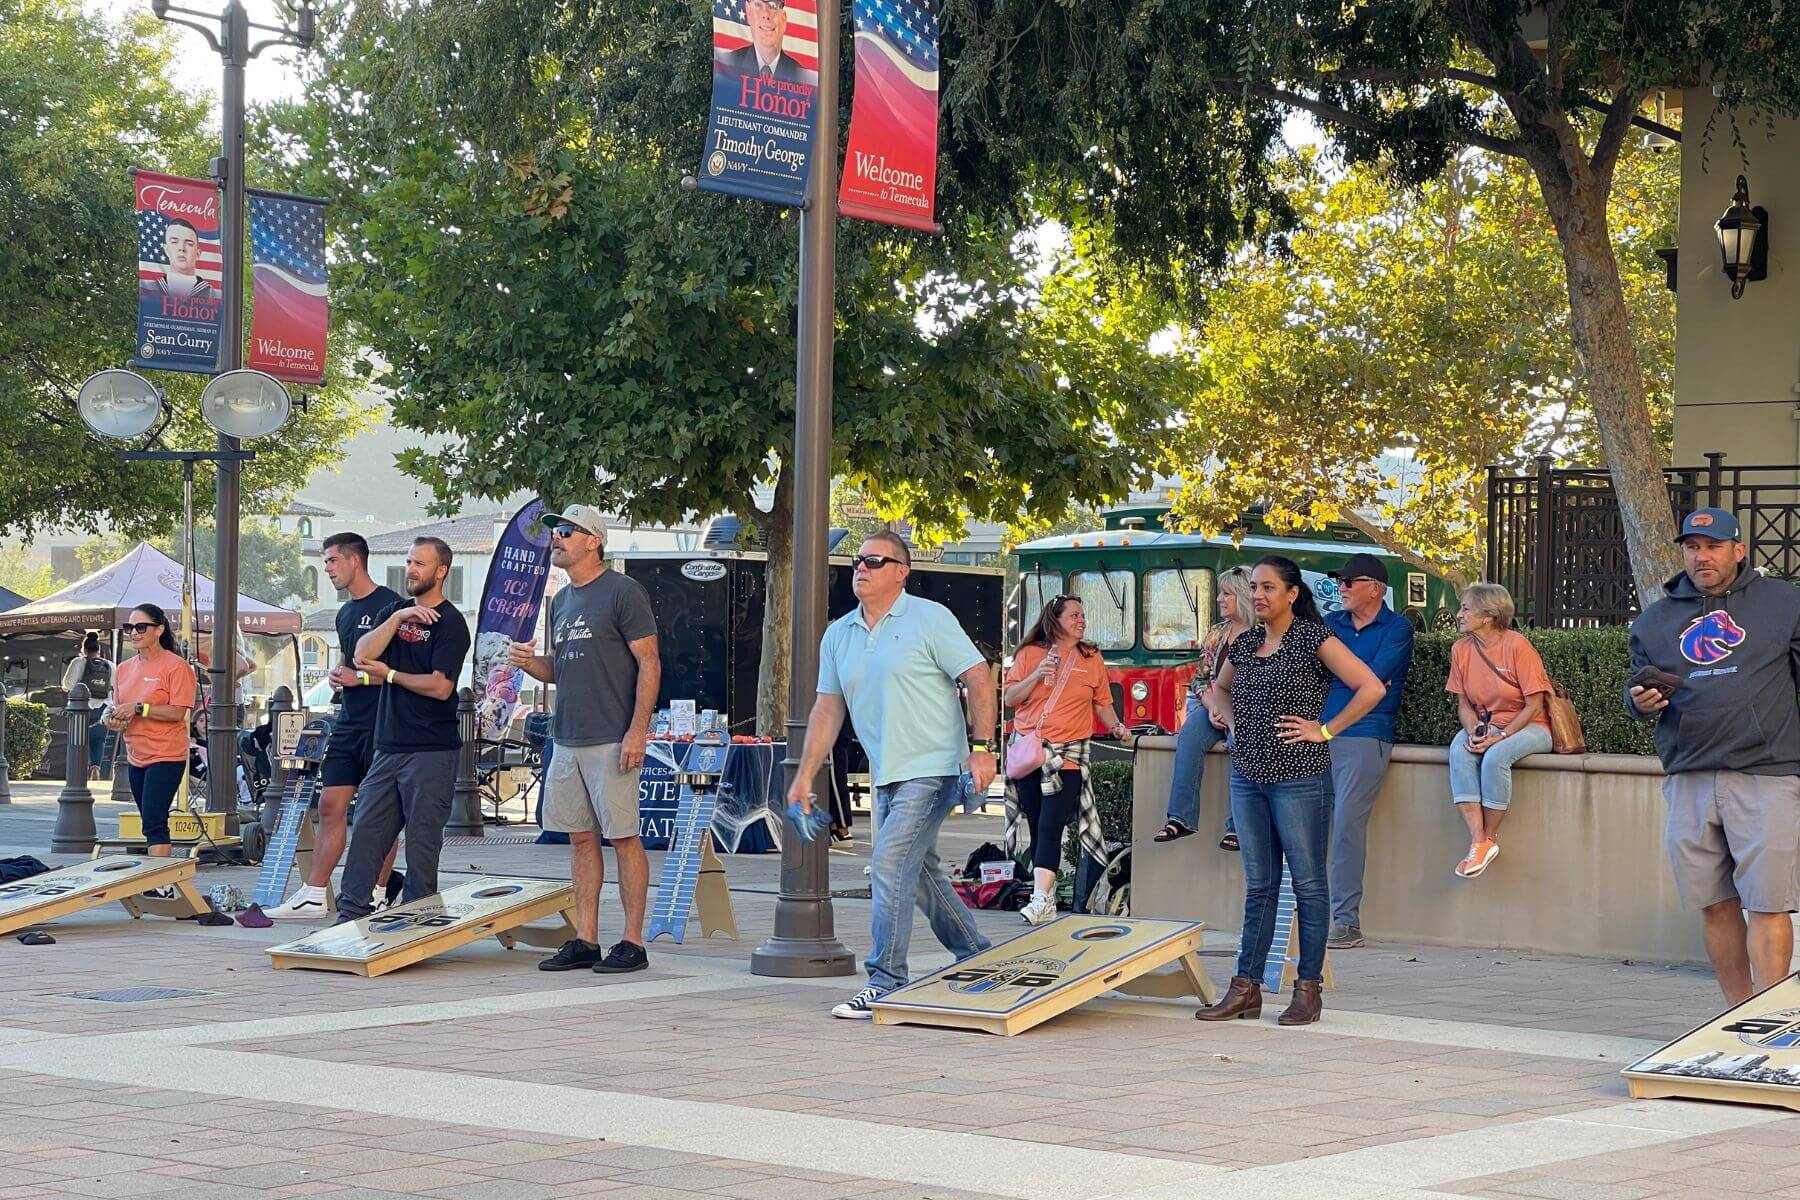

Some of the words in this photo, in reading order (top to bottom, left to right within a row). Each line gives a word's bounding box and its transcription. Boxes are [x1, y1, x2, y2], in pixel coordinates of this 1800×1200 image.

[740, 74, 811, 119] Honor
[777, 81, 813, 100] proudly
[717, 115, 762, 132] LIEUTENANT
[763, 124, 807, 141] COMMANDER
[714, 129, 763, 164] Timothy
[765, 139, 805, 171] George
[727, 161, 748, 172] NAVY
[855, 151, 923, 190] Welcome
[140, 185, 216, 220] Temecula
[880, 188, 888, 199] to
[889, 187, 929, 208] Temecula
[161, 293, 218, 320] Honor
[146, 329, 176, 345] Sean
[177, 333, 213, 354] Curry
[257, 338, 314, 360] Welcome
[155, 348, 172, 356] NAVY
[278, 360, 285, 368] to
[286, 359, 319, 372] Temecula
[504, 546, 535, 563] HAND
[912, 550, 938, 558] STREET
[501, 560, 545, 576] CRAFTED
[503, 579, 528, 596] ICE
[40, 615, 68, 624] CATERING
[69, 615, 81, 623] AND
[82, 614, 105, 623] EVENTS
[244, 616, 267, 625] BAR
